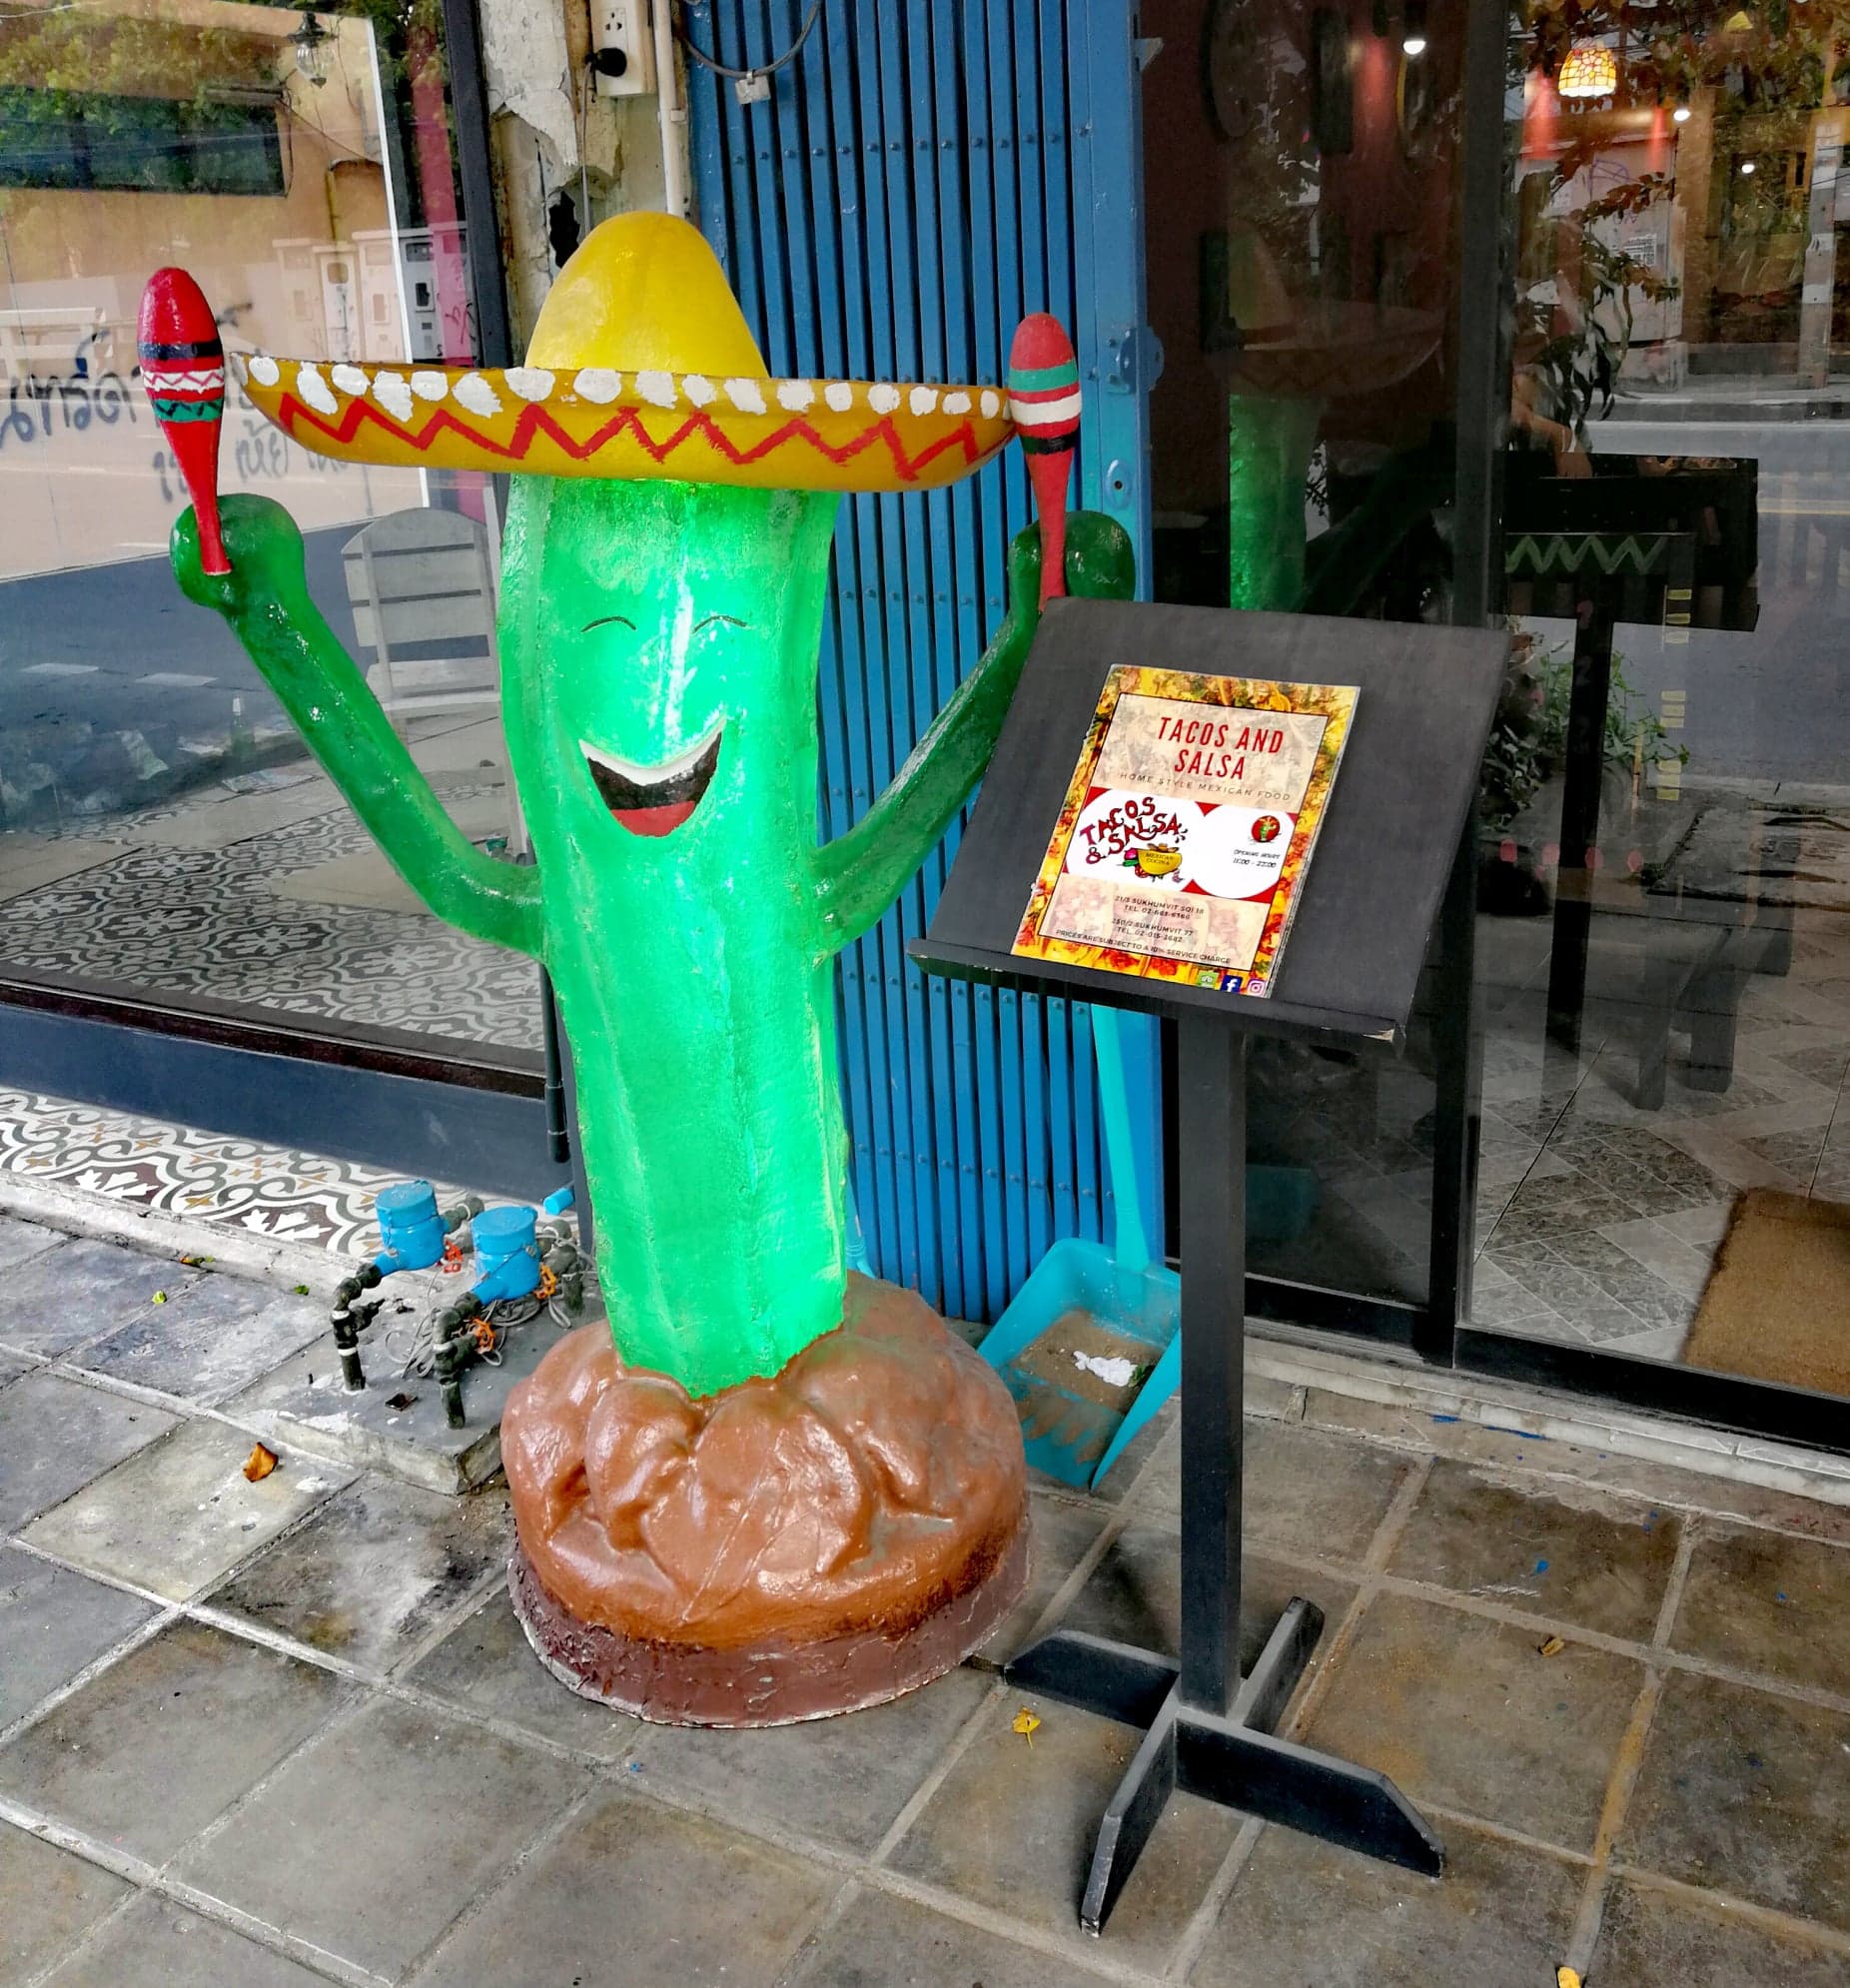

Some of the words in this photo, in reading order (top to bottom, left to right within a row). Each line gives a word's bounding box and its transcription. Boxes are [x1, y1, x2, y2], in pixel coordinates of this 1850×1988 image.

[1158, 717, 1229, 746] TACOS
[1236, 727, 1285, 753] AND
[1174, 749, 1246, 780] SALSA
[1120, 773, 1152, 783] HOME
[1159, 778, 1193, 789] STYLE
[1198, 783, 1253, 797] MEXICAN
[1258, 790, 1292, 801] FOOD
[1080, 796, 1156, 846] TACOS
[1086, 846, 1107, 865] &
[1108, 812, 1184, 855] SALSA
[1132, 898, 1178, 910] SUKHUMVIT
[1135, 921, 1182, 935] SUKHUMVIT
[1056, 929, 1082, 939] PRICES
[1099, 936, 1131, 948] SUBJECT
[1167, 949, 1199, 959] SERVICE
[1199, 954, 1231, 964] CHARGE
